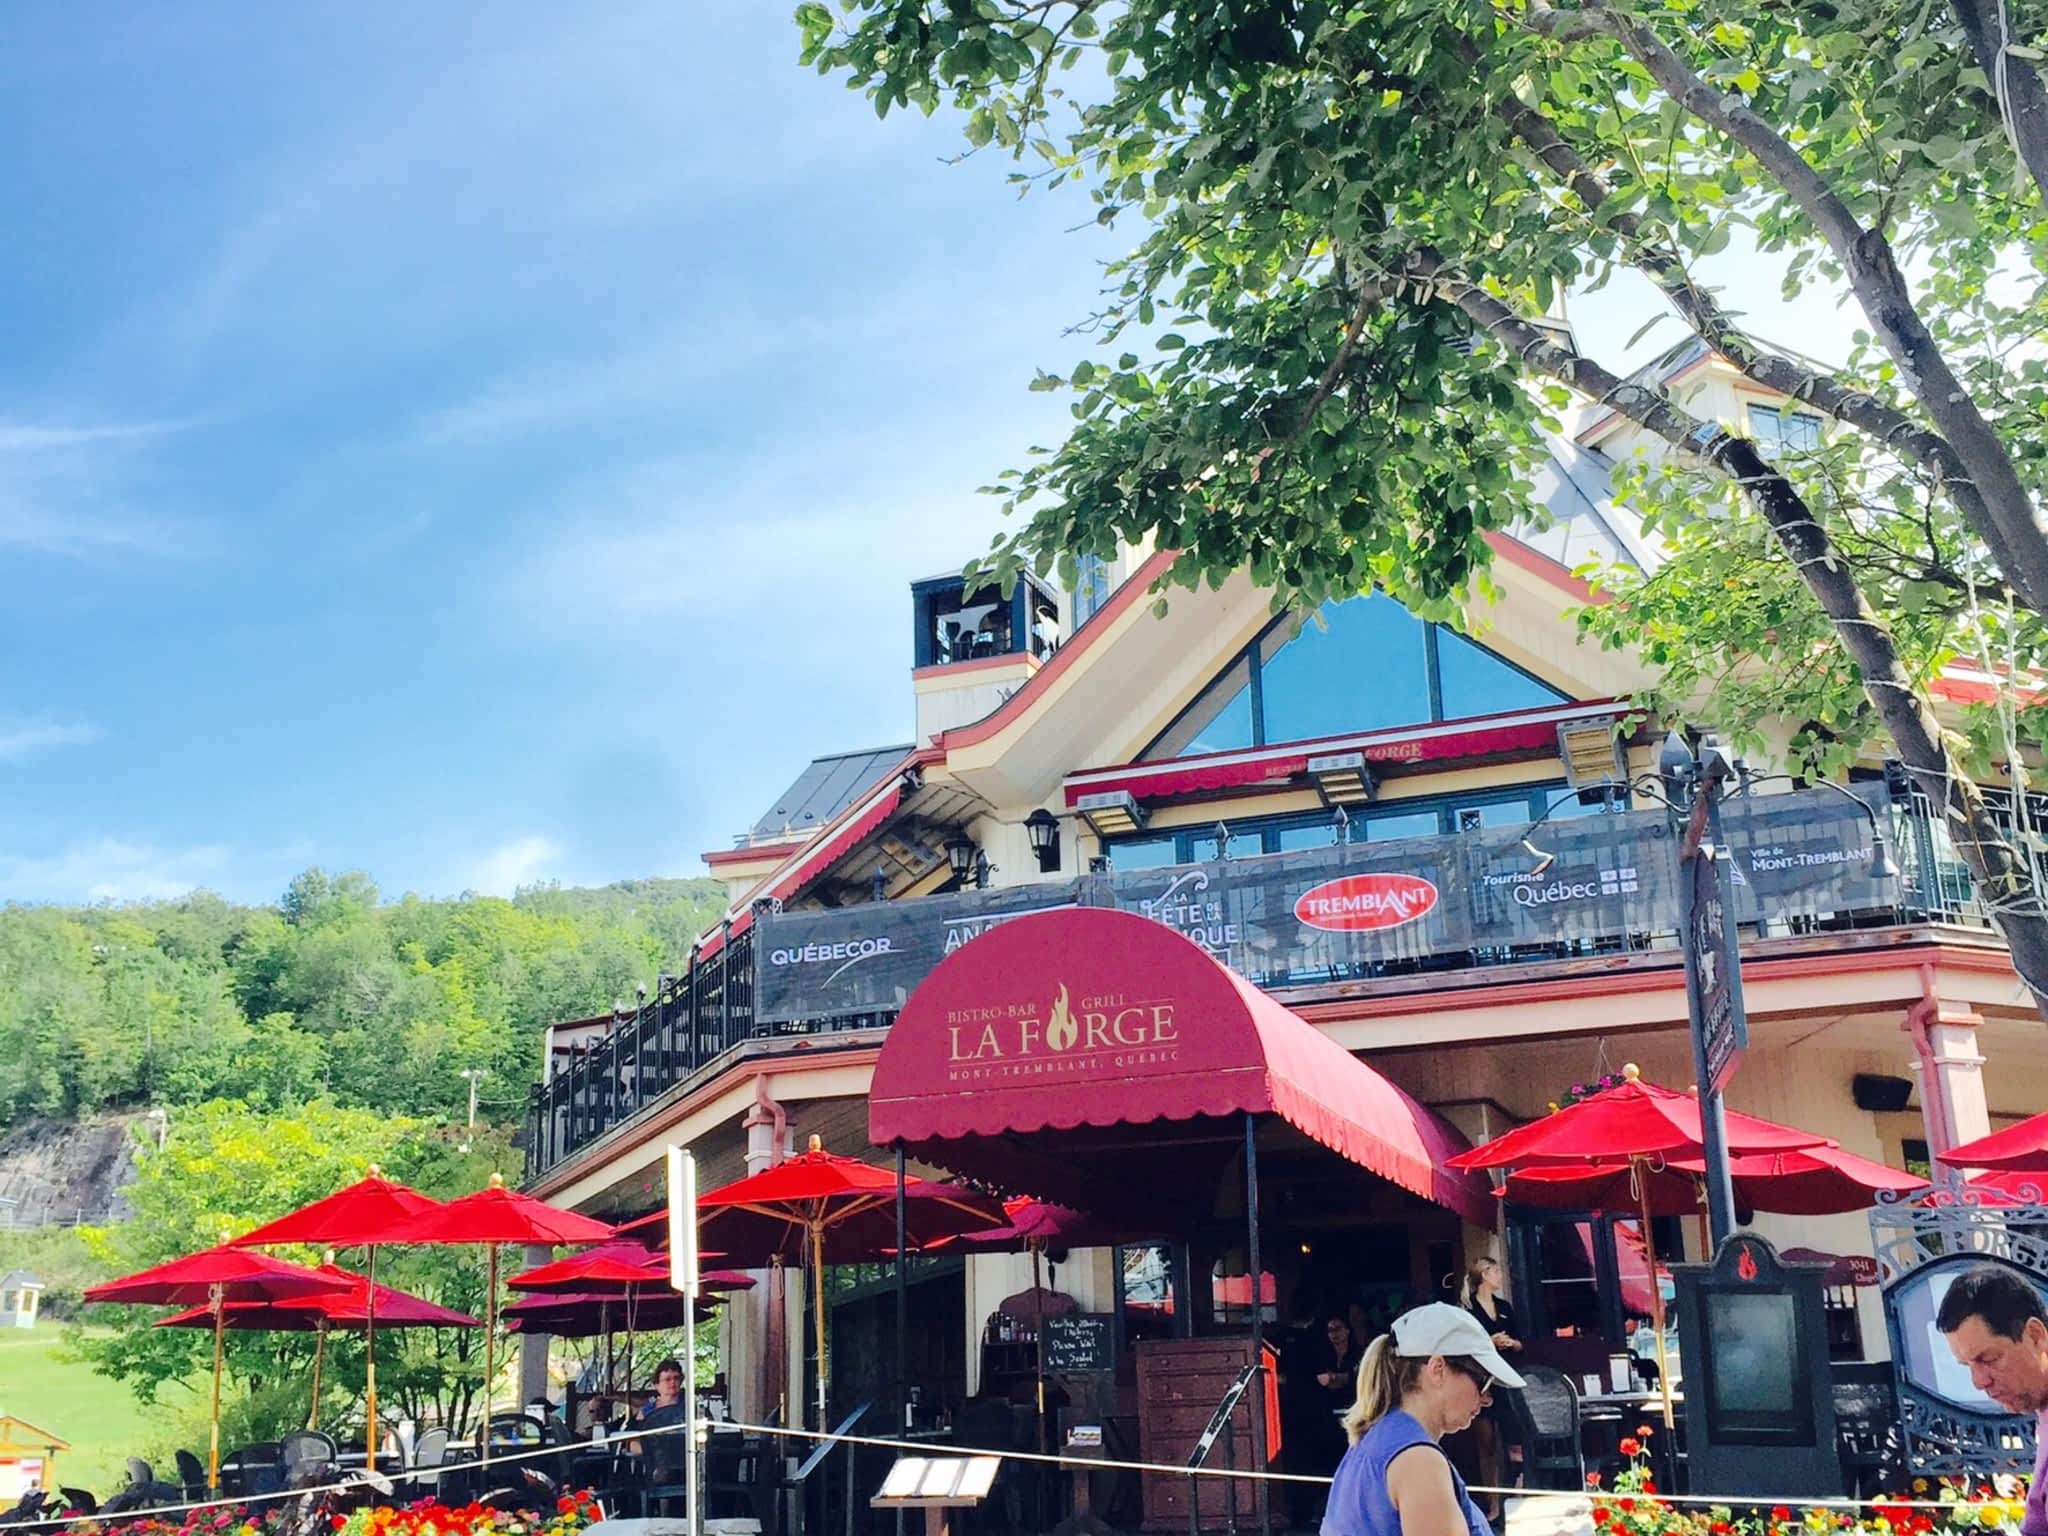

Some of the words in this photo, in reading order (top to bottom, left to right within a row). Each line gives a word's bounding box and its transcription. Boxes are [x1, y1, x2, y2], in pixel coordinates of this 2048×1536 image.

[1751, 848, 1771, 858] Ville
[1773, 847, 1785, 856] de
[1752, 848, 1873, 871] MONT-TREMBLANT
[1483, 871, 1545, 886] Tourisme
[1174, 893, 1188, 903] LA
[1306, 887, 1428, 918] TREMBLANT
[1513, 881, 1598, 907] Québec
[1182, 924, 1239, 945] QUE
[770, 936, 891, 966] QUÉBECOR
[1081, 994, 1126, 1010] GRILL
[948, 1023, 1004, 1061] LA
